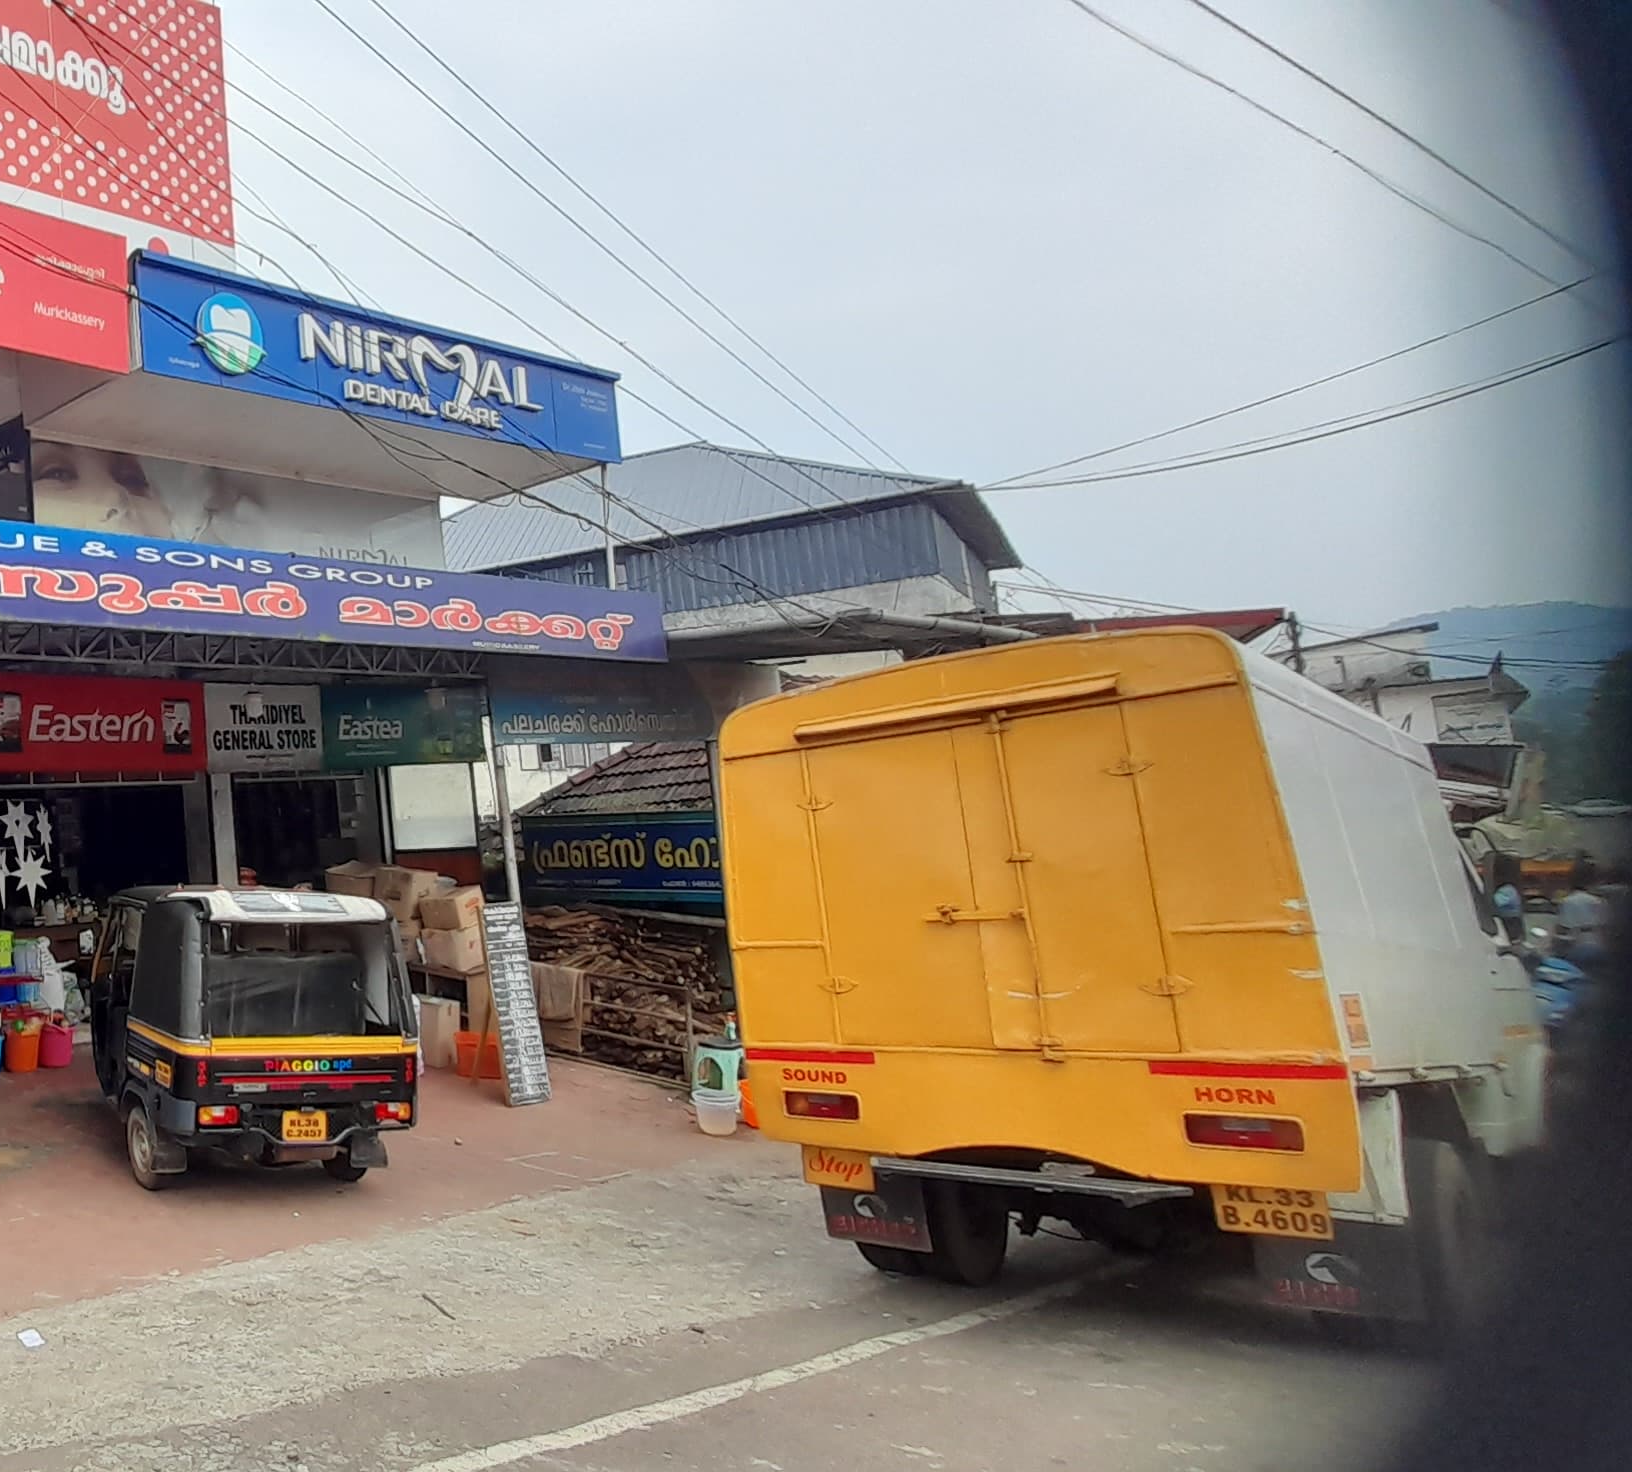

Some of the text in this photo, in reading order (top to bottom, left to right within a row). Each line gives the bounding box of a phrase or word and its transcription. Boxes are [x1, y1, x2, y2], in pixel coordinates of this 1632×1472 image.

[33, 301, 105, 331] Murickassery
[298, 313, 544, 412] NIRMAL
[344, 379, 503, 430] DENTAL CARE
[79, 540, 119, 558] &
[136, 546, 274, 575] SONS
[288, 564, 433, 589] GROUP
[29, 705, 154, 742] Eastern
[339, 714, 404, 740] Eastea
[213, 728, 317, 751] GENERAL STORE
[265, 1059, 330, 1072] PIAGGIO
[782, 1068, 847, 1084] SOUND
[1195, 1087, 1276, 1105] HORN
[809, 1150, 864, 1182] Stop
[1221, 1205, 1328, 1234] B.4609
